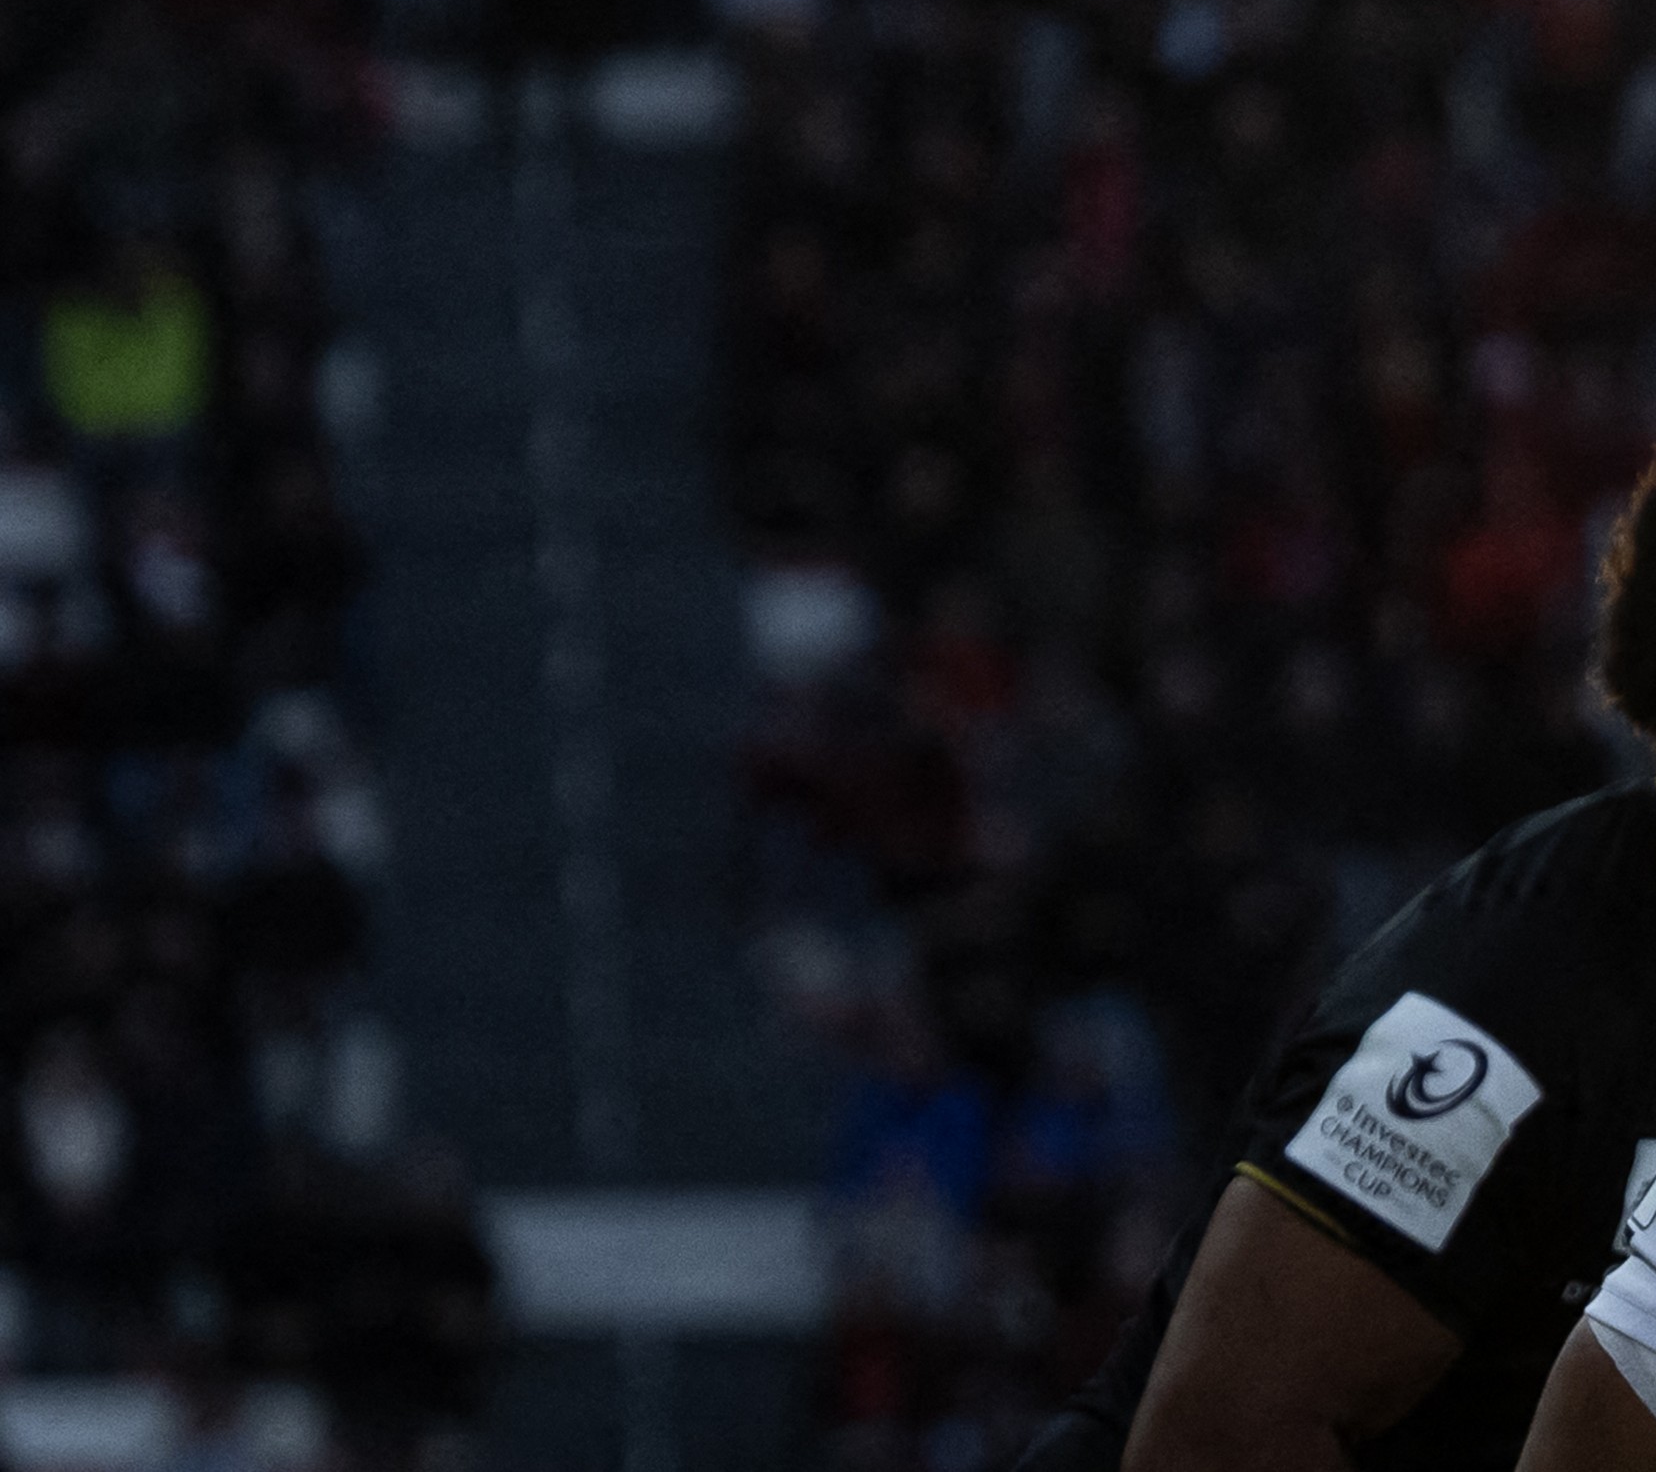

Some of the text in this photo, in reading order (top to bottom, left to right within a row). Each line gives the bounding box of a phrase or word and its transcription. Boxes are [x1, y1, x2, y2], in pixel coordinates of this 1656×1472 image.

[1319, 1114, 1449, 1210] CHAMPIONS
[1342, 1161, 1393, 1198] CUP
[1352, 1102, 1461, 1187] Investec
